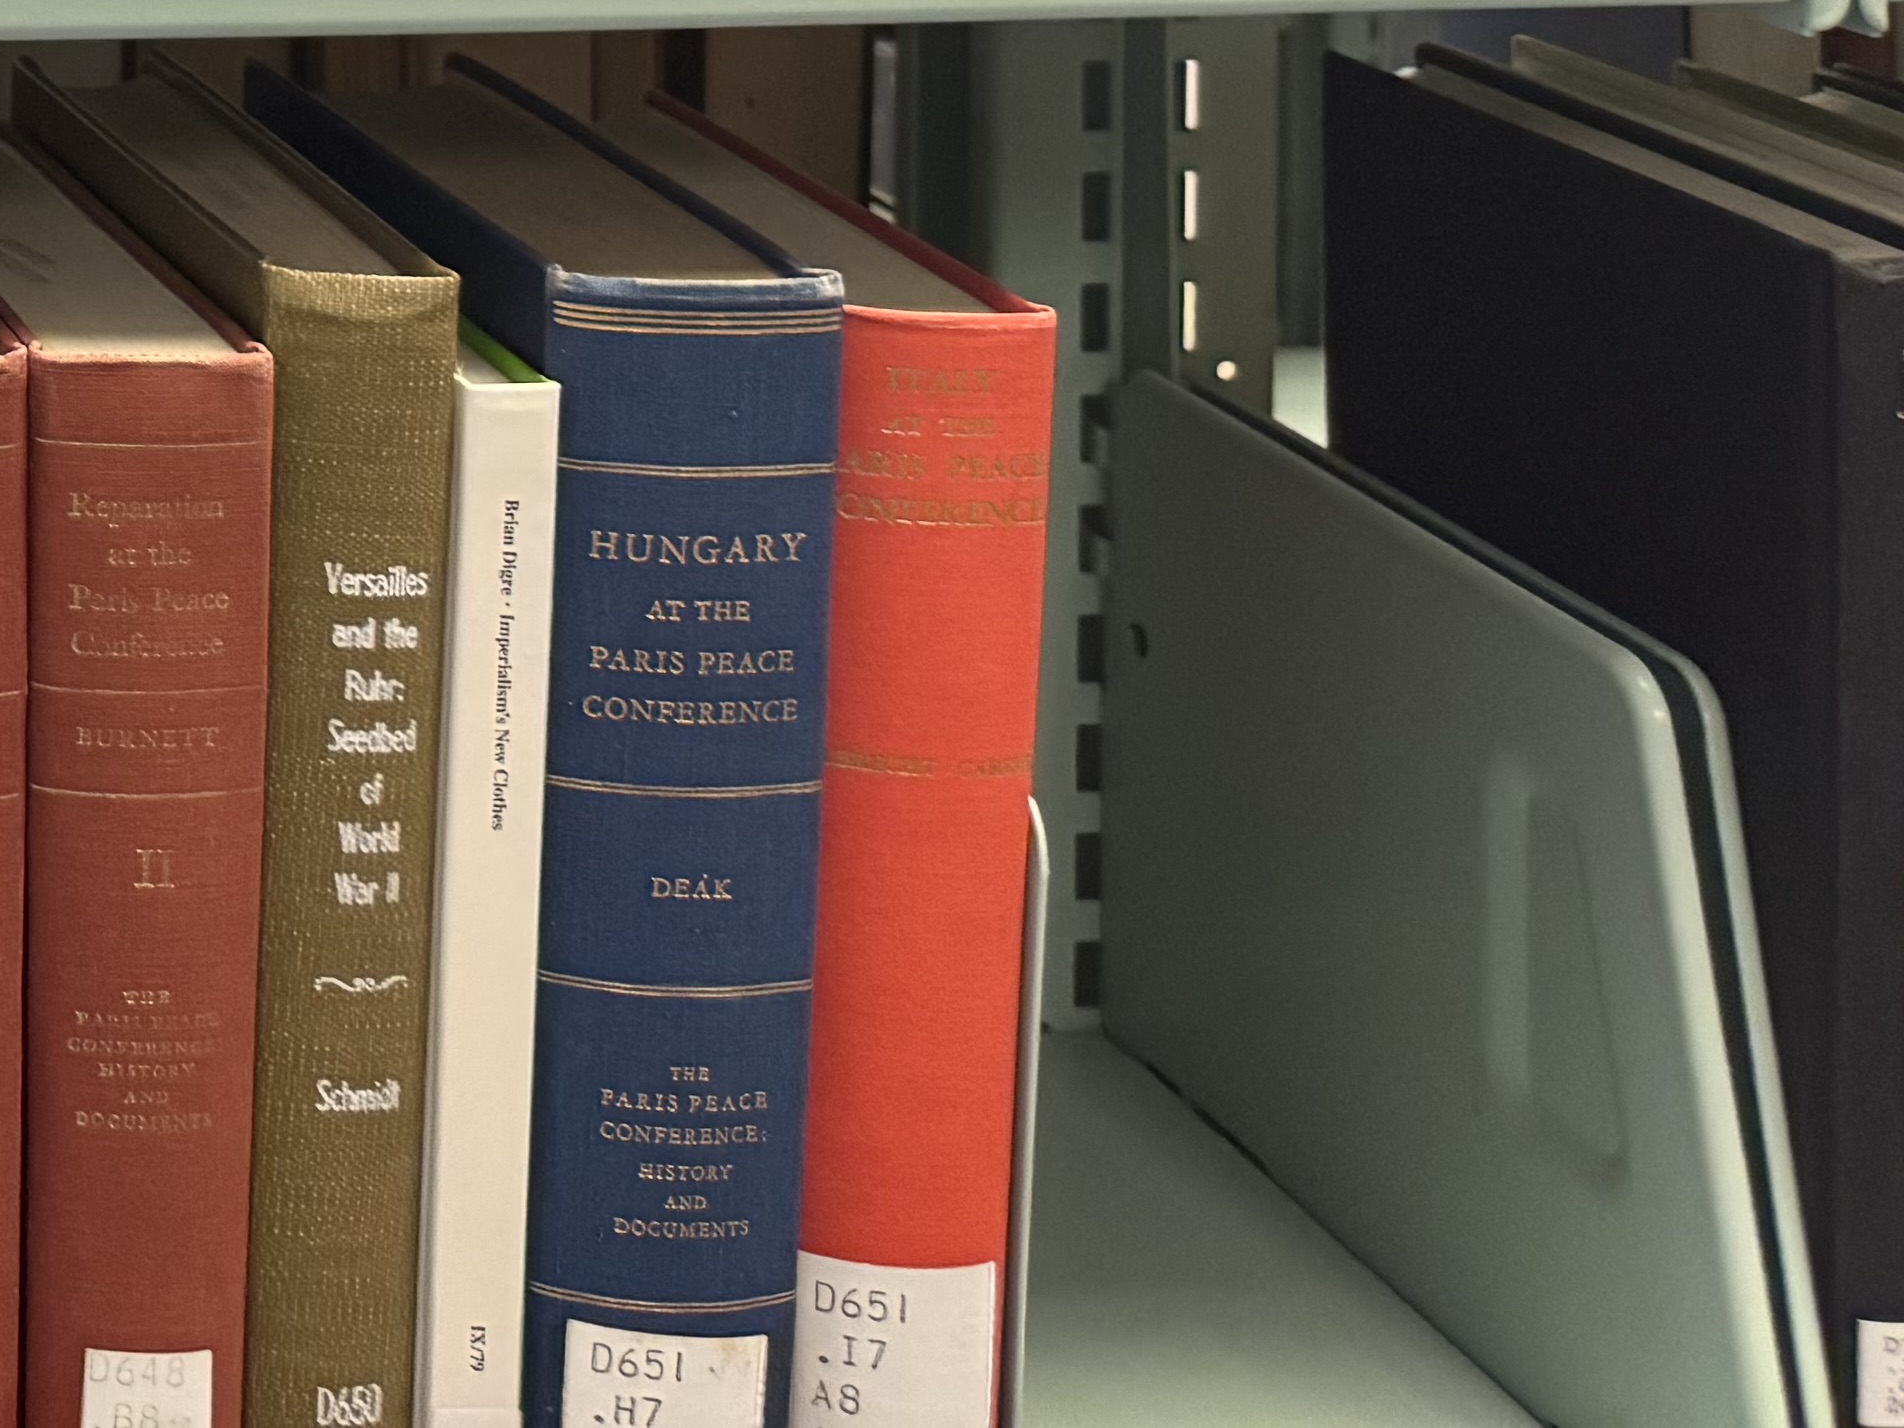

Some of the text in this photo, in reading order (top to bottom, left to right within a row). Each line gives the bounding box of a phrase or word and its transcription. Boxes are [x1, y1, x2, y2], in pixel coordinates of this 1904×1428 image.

[589, 530, 806, 564] HUNGARY
[646, 600, 751, 622] AT THE
[590, 647, 794, 675] PARIS PEACE
[582, 697, 799, 724] CONFERENCE
